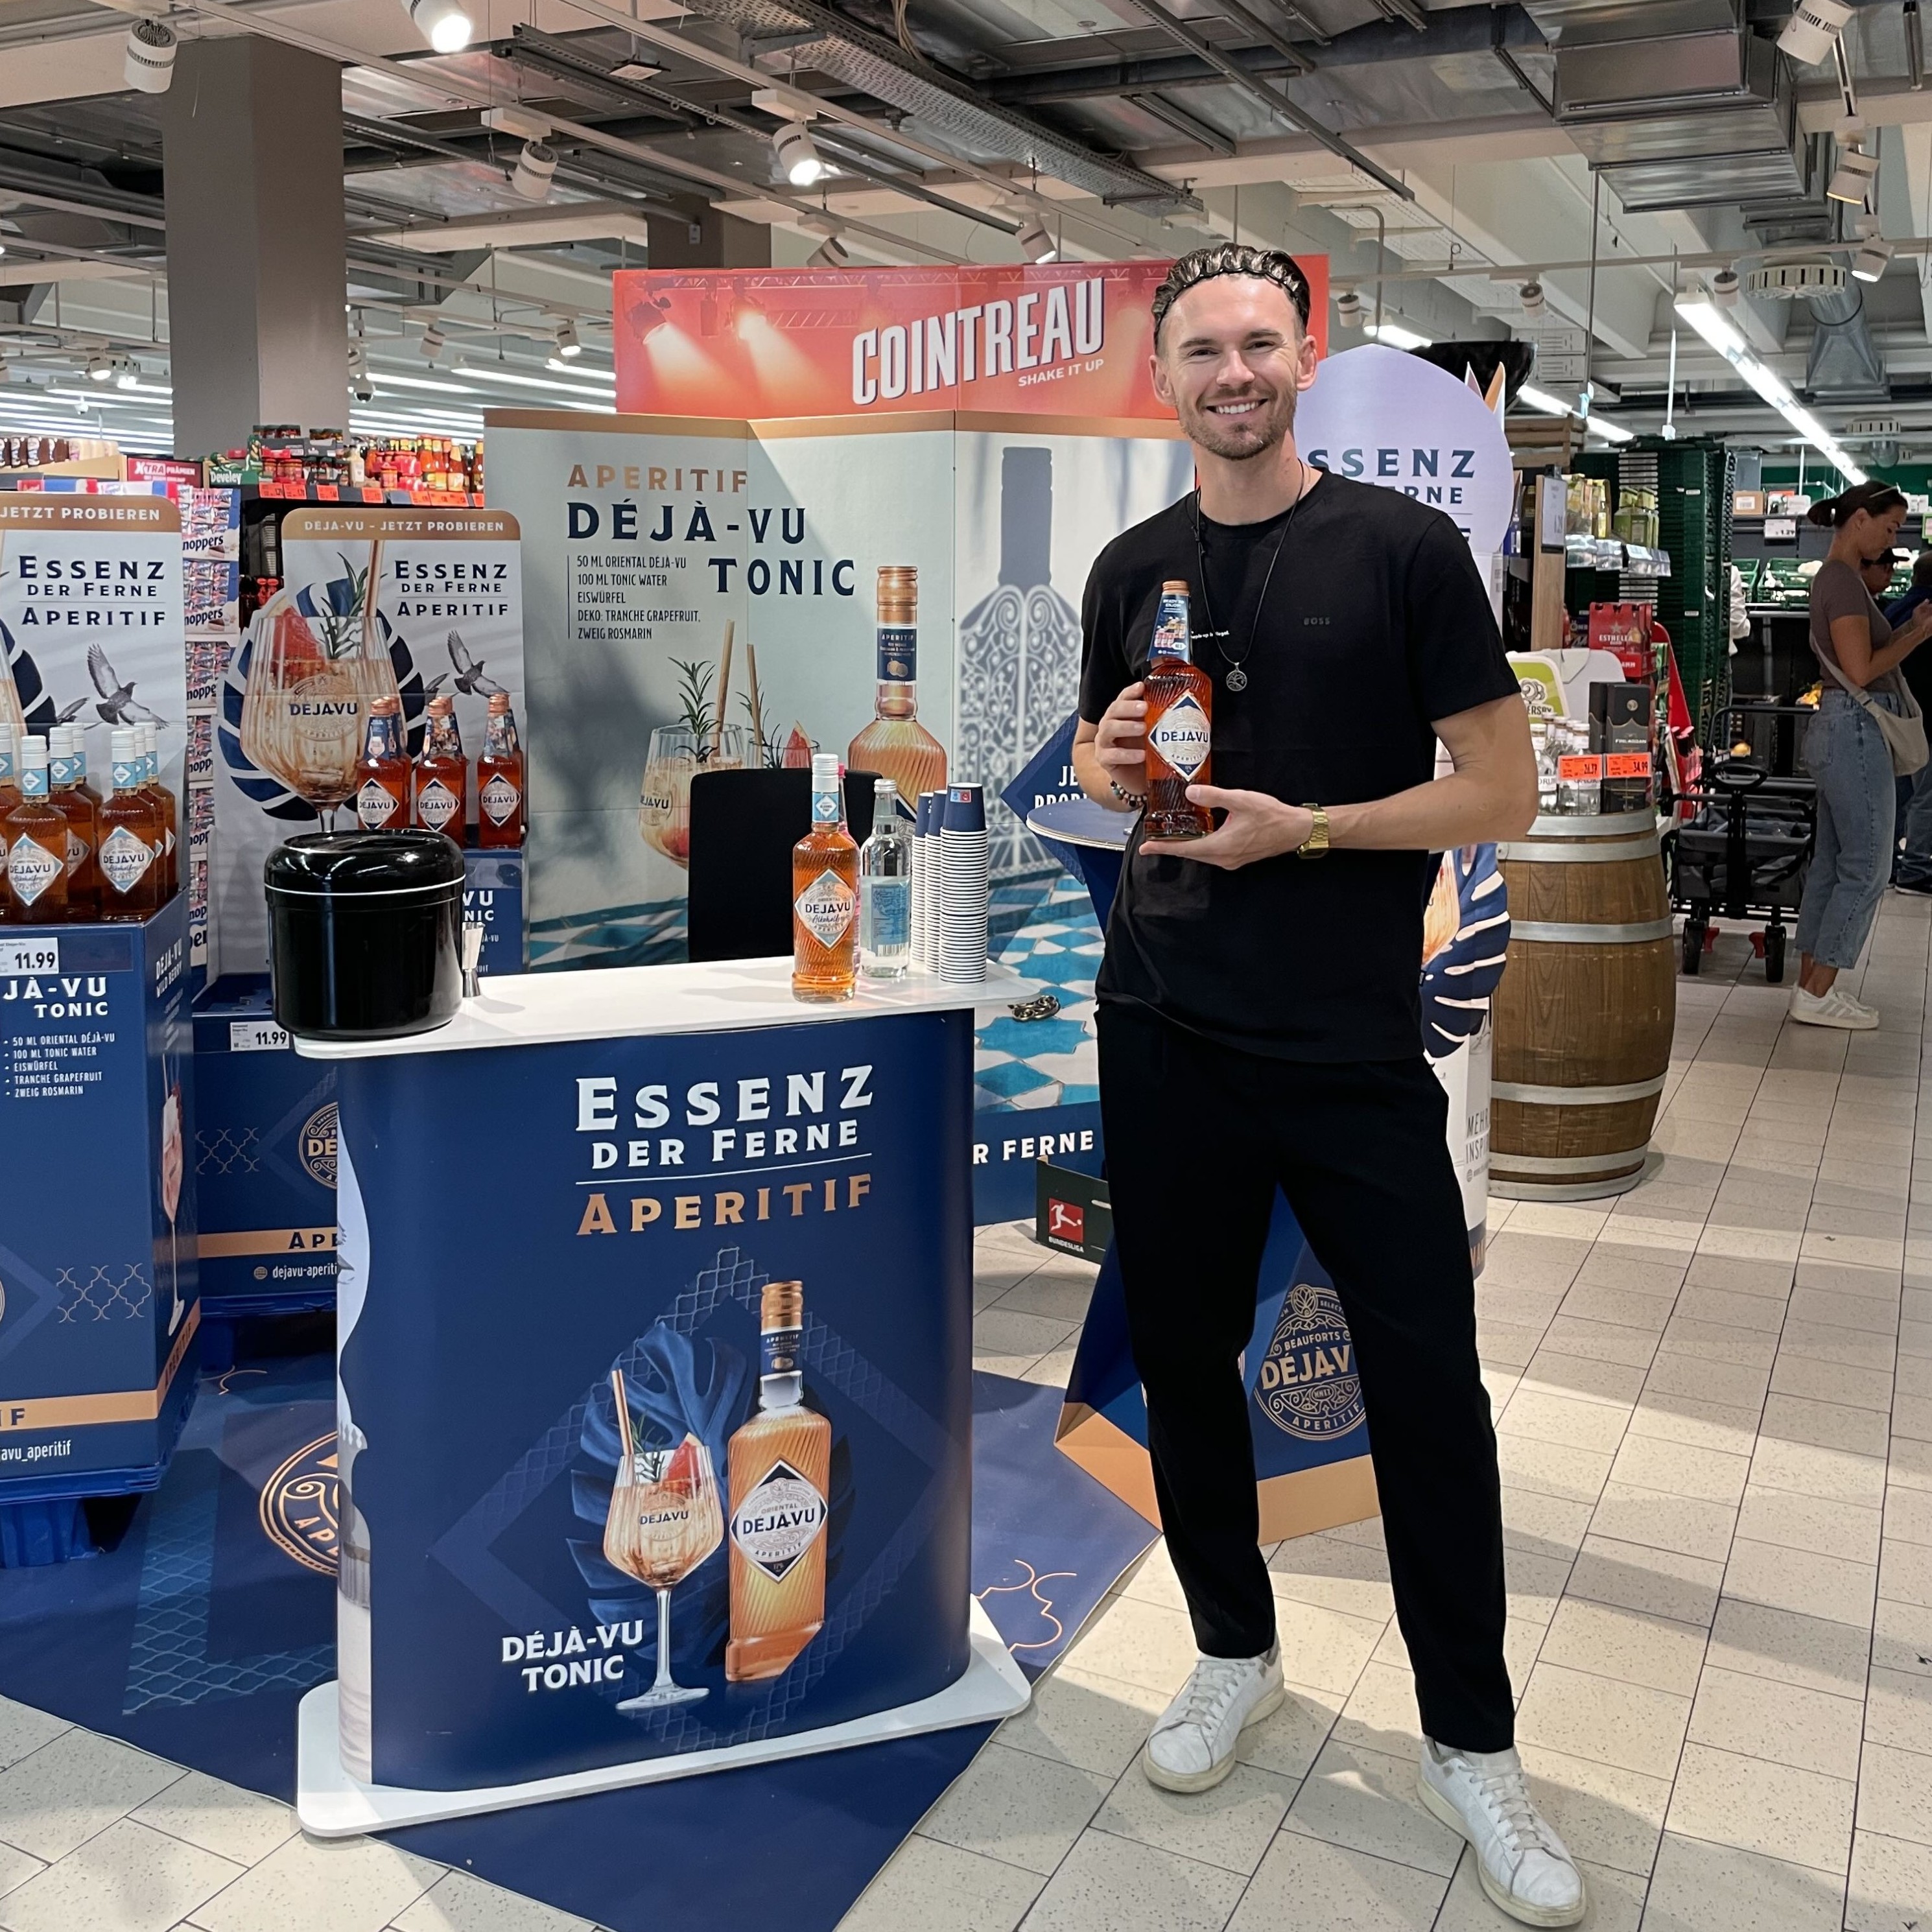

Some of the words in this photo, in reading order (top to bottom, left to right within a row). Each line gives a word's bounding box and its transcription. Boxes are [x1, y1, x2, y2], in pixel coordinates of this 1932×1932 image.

[853, 277, 1105, 405] COINTREAU
[1019, 368, 1064, 387] SHAKE
[1068, 363, 1081, 376] IT
[1085, 359, 1104, 372] UP
[1308, 449, 1475, 478] SSENZ
[210, 471, 242, 484] Develey
[567, 464, 748, 493] APERITIF
[1404, 486, 1463, 504] RNE
[0, 508, 54, 518] JETZT
[62, 508, 160, 520] PROBIEREN
[567, 498, 805, 544] DÉJÀ-VU
[381, 521, 422, 531] JETZT
[428, 522, 504, 532] PROBIEREN
[182, 536, 224, 551] noppers
[19, 556, 165, 579] ESSENZ
[395, 560, 507, 579] ESSENZ
[577, 556, 588, 567] 50
[591, 556, 603, 567] ML
[606, 556, 646, 568] ORIENTAL
[578, 574, 593, 585] 100
[596, 574, 608, 585] ML
[611, 574, 636, 585] TONIC
[639, 574, 667, 586] WATER
[708, 558, 855, 596] TONIC
[27, 585, 70, 596] DER
[84, 583, 157, 596] FERNE
[401, 583, 434, 593] DER
[445, 582, 501, 593] FERNE
[578, 591, 626, 604] EISWÜRFEL
[22, 607, 165, 625] APERITIF
[184, 608, 223, 626] noppers
[397, 602, 508, 616] APERITIF
[606, 610, 644, 622] TRANCHE
[578, 628, 606, 639] ZWEIG
[608, 628, 652, 640] ROSMARIN
[187, 684, 216, 700] noppe
[465, 910, 494, 921] NIC
[15, 952, 55, 969] 11.99
[3, 976, 106, 1000] JÀ-VU
[34, 1002, 108, 1018] TONIC
[13, 1037, 23, 1046] 50
[27, 1037, 38, 1046] ML
[40, 1035, 78, 1045] ORIENTAL
[255, 1031, 287, 1045] 11.99
[14, 1050, 27, 1059] 100
[30, 1049, 41, 1059] ML
[45, 1048, 68, 1058] TONIC
[71, 1047, 97, 1057] WATER
[14, 1061, 58, 1072] EISWÜRFEL
[15, 1074, 51, 1085] TRANCHE
[54, 1072, 102, 1083] GRAPEFRUIT
[14, 1088, 40, 1098] ZWEIG
[42, 1086, 84, 1096] ROSMARIN
[576, 1065, 873, 1131] ESSENZ
[592, 1138, 685, 1169] DER
[713, 1119, 858, 1162] FERNE
[1003, 1130, 1093, 1160] FERNE
[576, 1173, 871, 1235] APERITIF
[1048, 1236, 1084, 1253] BUNDESLIGA
[272, 1263, 337, 1280] dejavu-aperiti
[1284, 1331, 1340, 1351] BEAUFORTS
[1261, 1345, 1352, 1390] DÉJÀV
[1293, 1402, 1360, 1430] APERITIF
[0, 1440, 71, 1462] avu_aperitif
[761, 1503, 797, 1514] ORIENTAL
[756, 1542, 801, 1557] APERITIF
[502, 1620, 643, 1662] DÉJÀ-VU
[521, 1655, 624, 1691] TONIC
